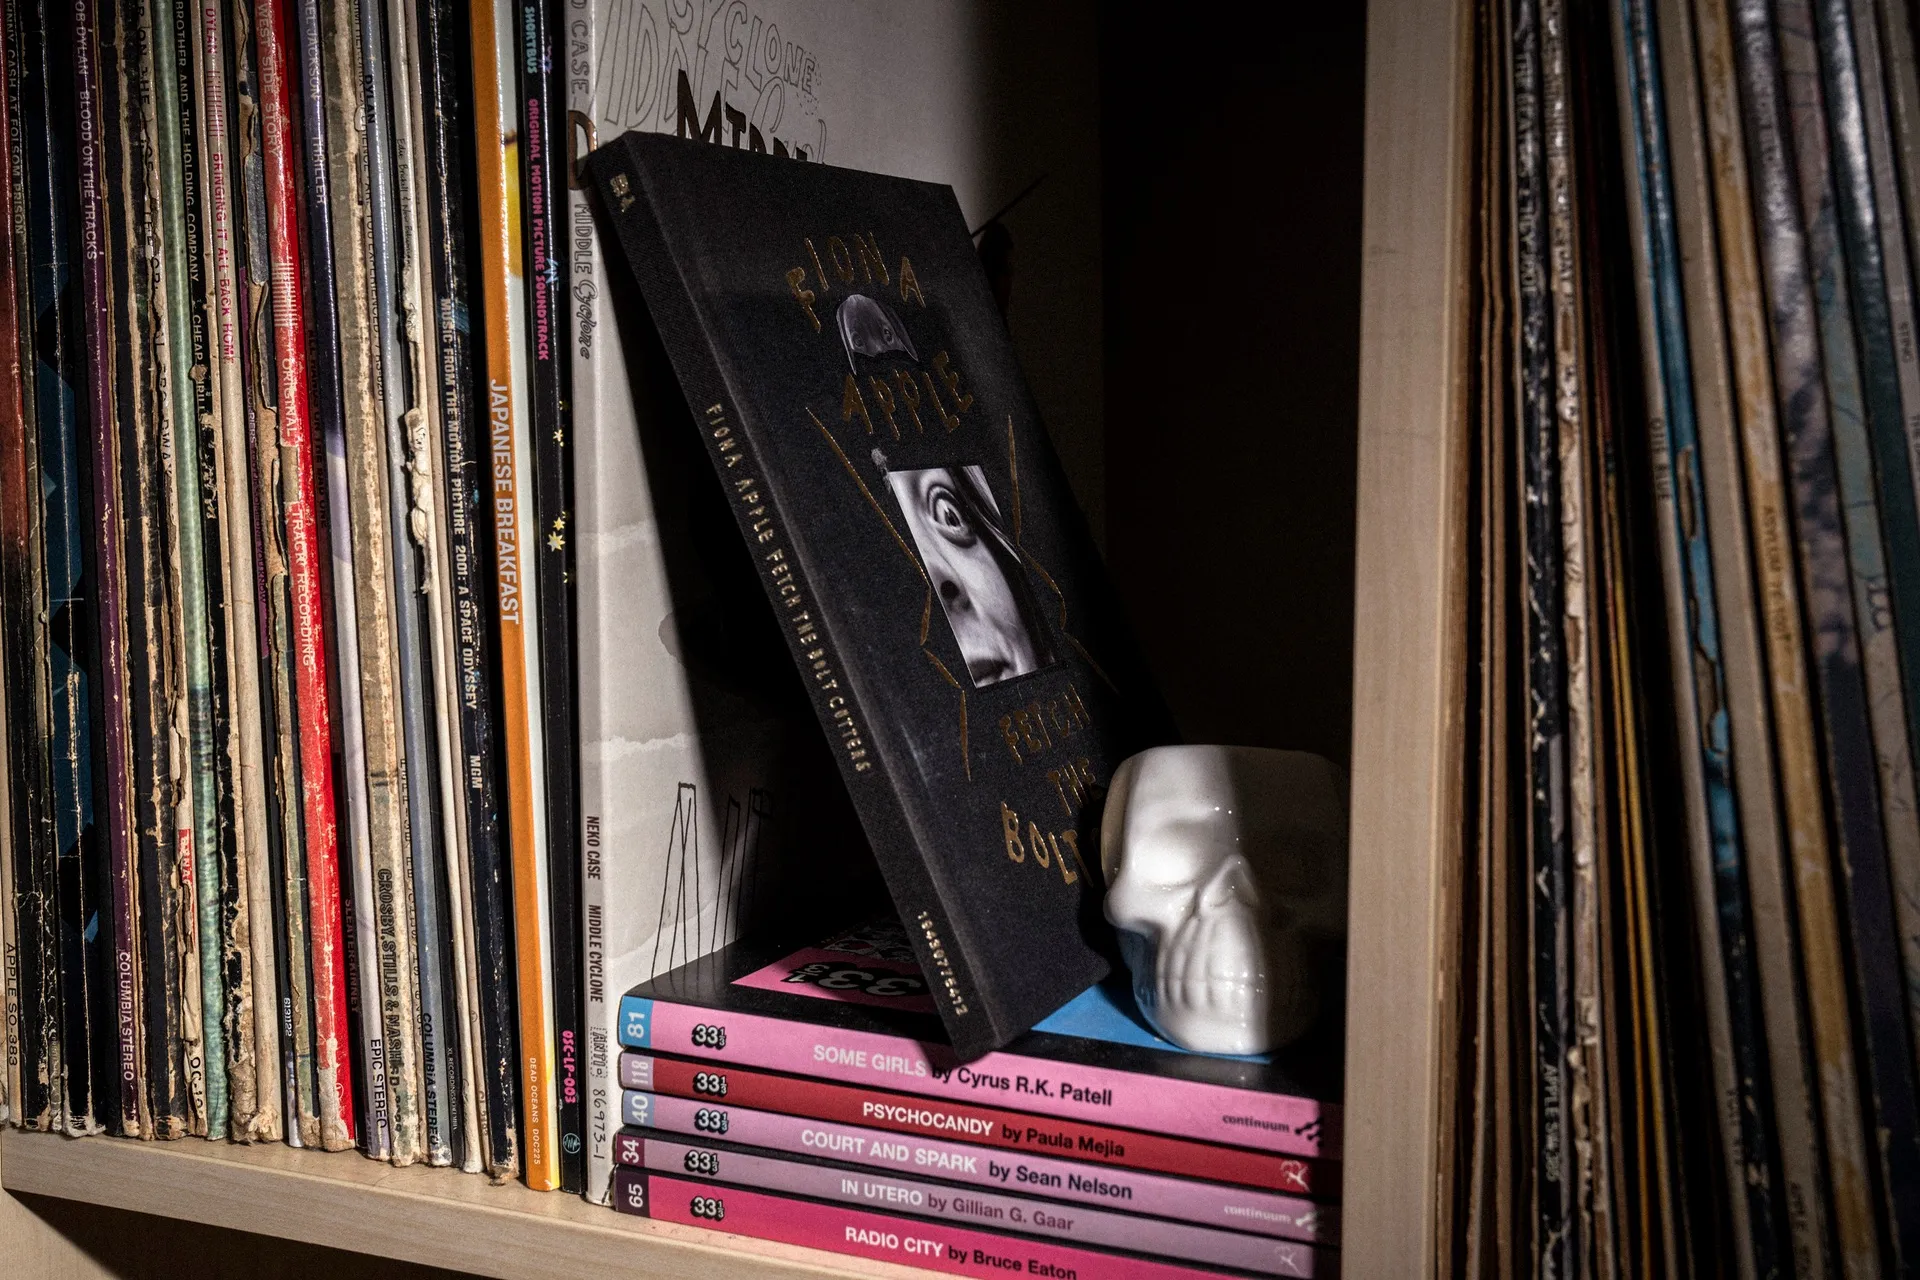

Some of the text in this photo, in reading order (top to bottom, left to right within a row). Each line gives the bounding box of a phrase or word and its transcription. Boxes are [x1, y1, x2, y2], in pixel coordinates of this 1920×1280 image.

[76, 27, 90, 75] DYLAN
[138, 29, 148, 57] ON
[175, 1, 188, 67] BROTHER
[204, 8, 219, 55] DYLAN
[257, 3, 272, 47] WEST
[570, 19, 590, 96] CASE
[8, 48, 17, 88] CASH
[179, 74, 190, 103] AND
[261, 56, 274, 94] SIDE
[306, 29, 321, 101] JACKSON
[9, 95, 18, 112] AT
[79, 91, 94, 141] BLOOD
[181, 109, 191, 137] THE
[264, 103, 279, 158] STORY
[364, 73, 376, 125] DYLAN
[11, 118, 21, 176] FOLSOM
[81, 146, 94, 167] ON
[183, 143, 194, 207] HOLDING
[399, 164, 409, 193] Brickell
[14, 182, 24, 235] PRISON
[83, 172, 96, 199] THE
[213, 153, 226, 222] BRINGING
[524, 6, 551, 361] SHORTBUS ORIGINAL MOTION PICTURE SOUNDTRACK
[85, 204, 99, 261] TRACKS
[186, 213, 199, 283] COMPANY
[216, 228, 227, 242] IT
[218, 248, 229, 273] ALL
[220, 279, 233, 317] BACK
[573, 203, 599, 361] MIDDLE Cyclone
[784, 231, 927, 335] FIONA
[192, 314, 204, 361] CHEAP
[283, 358, 299, 438] ORIGINAL
[841, 350, 976, 442] APPLE
[490, 379, 520, 625] JAPANESE BREAKFAST
[440, 298, 484, 790] MUSIC FROM THE MOTION PICTURE 2001: A SPACE ODYSSEY MGM
[704, 402, 872, 773] FIONA APPLE FETCH THE BOLT CUTTERS
[297, 573, 313, 668] RECORDING
[999, 681, 1092, 766] FETCH
[1000, 800, 1095, 889] BOLT
[586, 815, 605, 1003] NEKO CASE MIDDLE CYCLONE
[345, 898, 359, 1015] SLEATER-KINNEY
[382, 944, 399, 998] STILLS
[6, 942, 19, 1067] APPLE SO-383
[119, 951, 135, 1081] COLUMBIA STEREO
[283, 996, 294, 1038] 6131122
[385, 1000, 399, 1012] &
[387, 1015, 401, 1064] NASH
[561, 1029, 577, 1105] OSC-LP-003
[627, 1010, 1290, 1133] 81 SOME GIRLS by Cyrus R.K. Patell continuum
[370, 1039, 388, 1129] EPIC STEREO
[529, 1057, 543, 1165] DEAD OCEANS DOC225
[630, 1059, 1125, 1158] 118 PSYCHOCANDY by Paula Mejia
[1543, 1062, 1559, 1116] APPLE
[427, 1090, 440, 1147] STEREO
[593, 1087, 607, 1160] 86973-1
[621, 1138, 1074, 1231] 34 IN UTERO by Gillian G. Gaar
[630, 1094, 1292, 1225] 40 COURT AND SPARK by Sean Nelson continuum
[628, 1183, 1077, 1280] 65 RADIO CITY by Bruce Eaton
